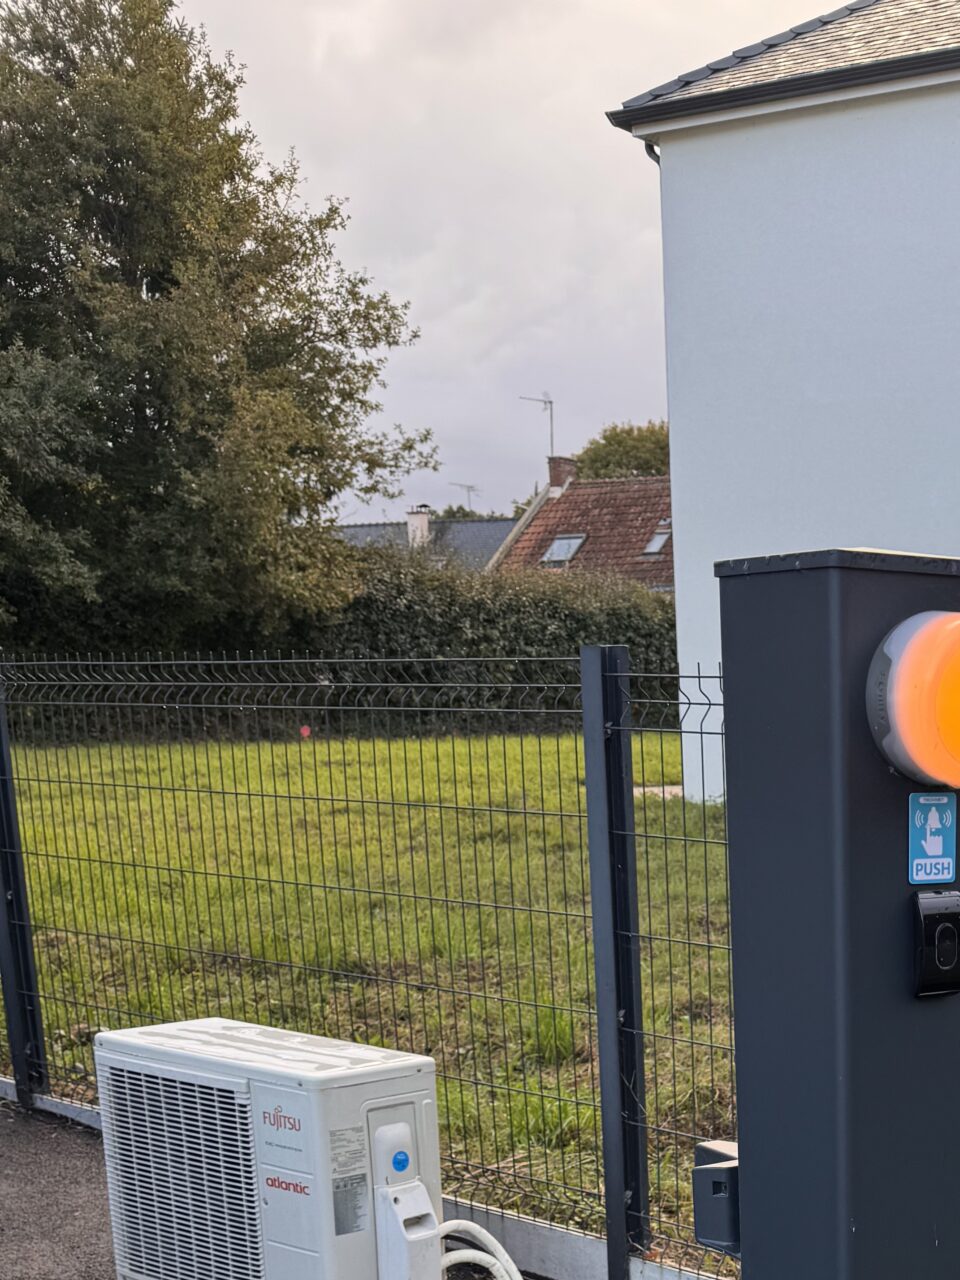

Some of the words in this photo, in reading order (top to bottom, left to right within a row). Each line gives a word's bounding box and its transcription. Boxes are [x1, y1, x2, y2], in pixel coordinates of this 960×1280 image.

[915, 862, 951, 876] PUSH
[262, 1105, 302, 1131] FUJITSU
[266, 1176, 310, 1196] atlantic
